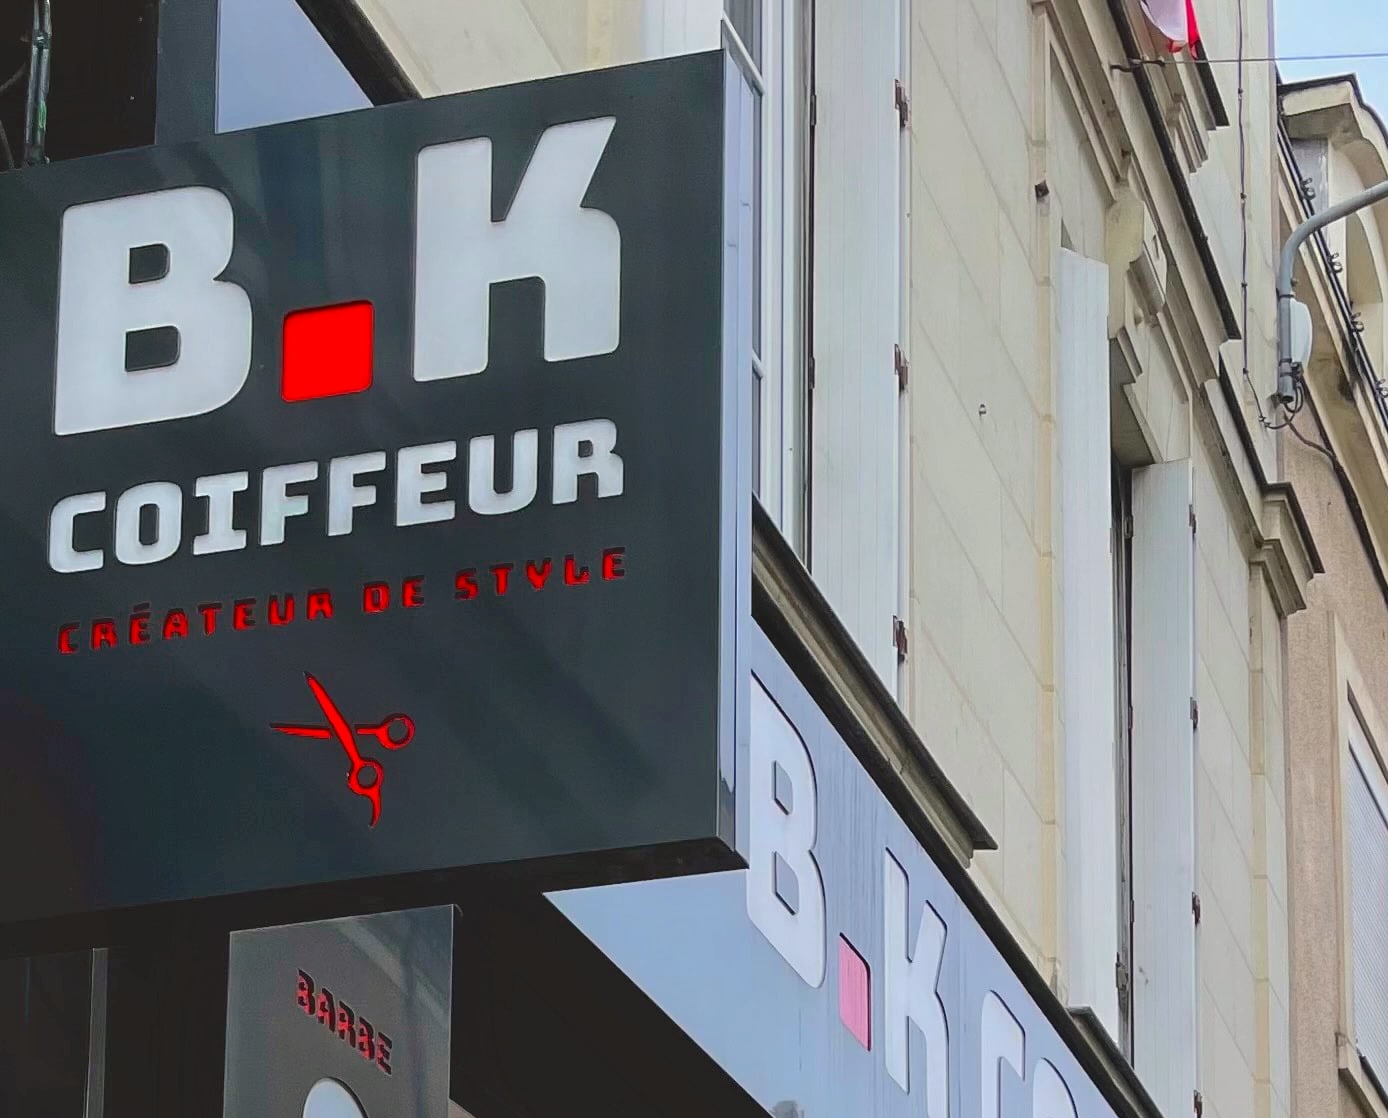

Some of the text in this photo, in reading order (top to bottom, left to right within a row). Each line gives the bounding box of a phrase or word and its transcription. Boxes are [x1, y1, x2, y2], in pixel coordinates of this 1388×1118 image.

[47, 418, 625, 575] COIFFEUR
[58, 546, 627, 655] CRÉATEUR DE STYLE
[296, 969, 393, 1076] BARBE
